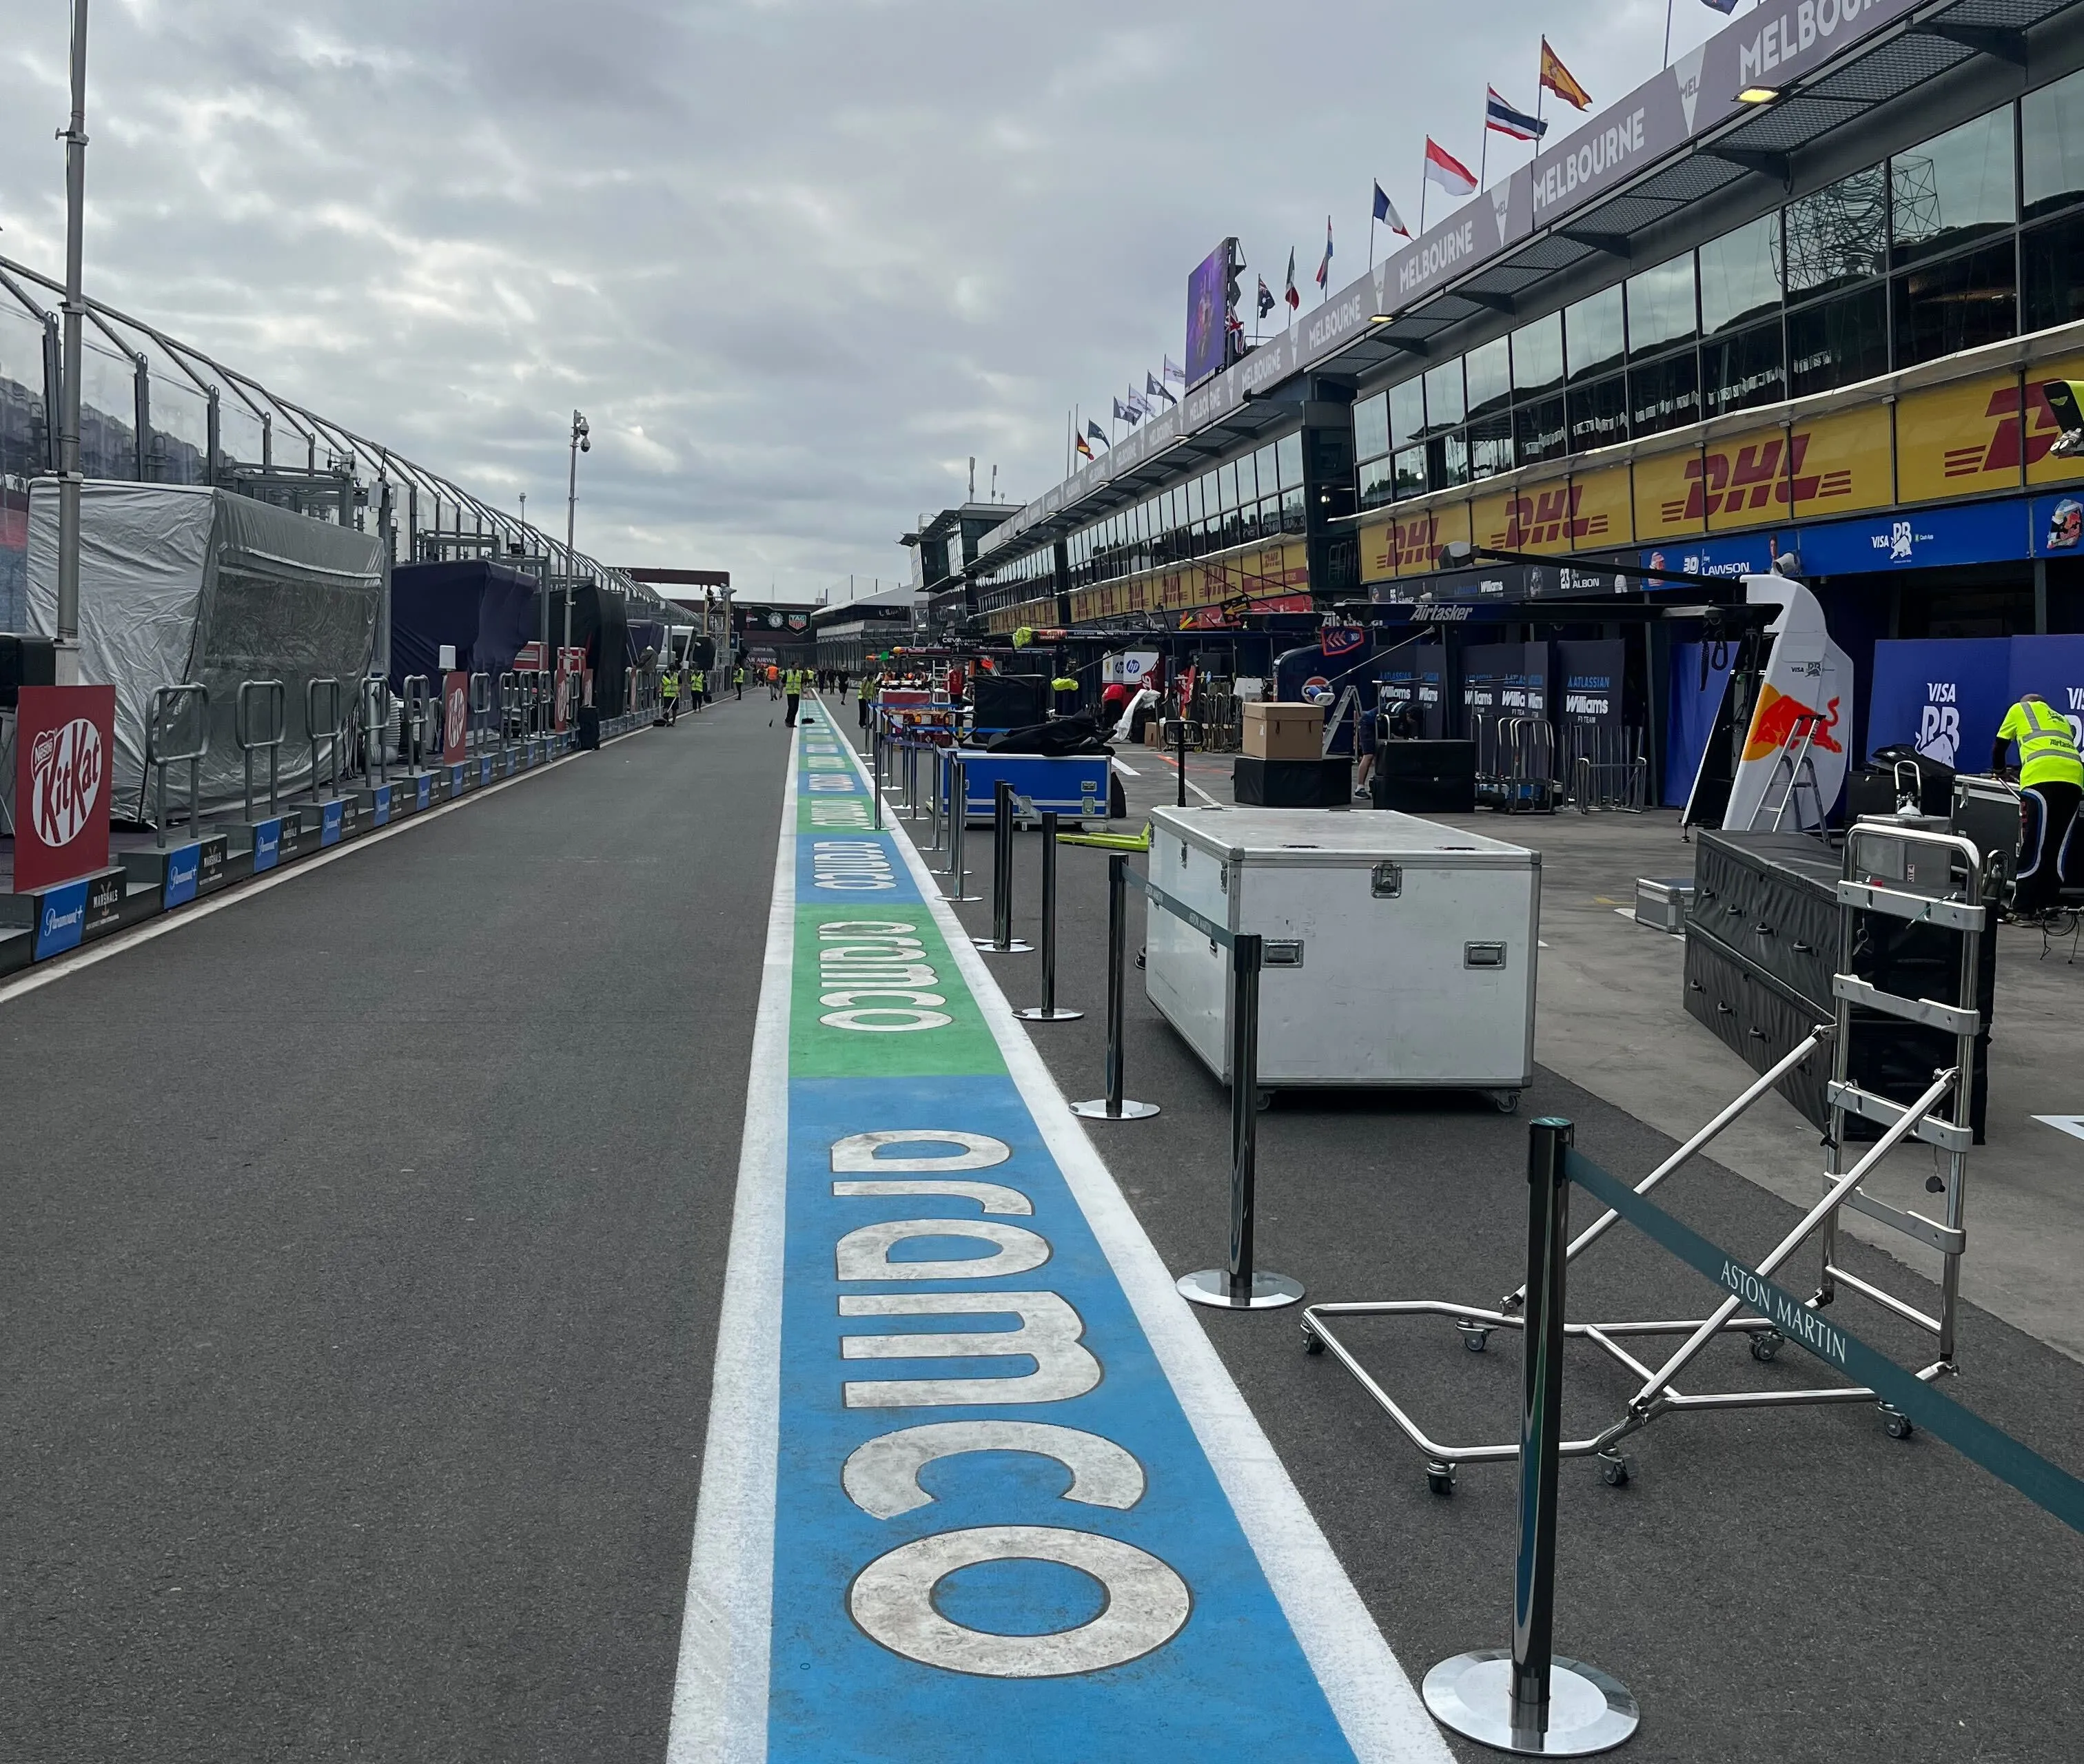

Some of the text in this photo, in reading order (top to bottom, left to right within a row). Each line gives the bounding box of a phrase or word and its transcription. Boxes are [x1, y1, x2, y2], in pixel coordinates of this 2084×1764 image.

[1679, 75, 1699, 99] MEL
[1533, 107, 1645, 213] MELBOURNE
[1399, 220, 1474, 294] MELBOURNE
[1309, 294, 1362, 350] MELBOURNE
[1241, 347, 1282, 391] MELBOURNE
[1684, 433, 1821, 520] DHL
[1505, 484, 1590, 549] DHL
[1385, 517, 1444, 568] DHL
[1871, 535, 1890, 548] VISA
[1683, 556, 1699, 574] 30
[1702, 562, 1750, 576] LAWSON
[1480, 580, 1504, 594] Williams
[1560, 568, 1570, 589] 23
[1572, 577, 1600, 589] ALBON
[1409, 604, 1473, 621] Airtasker
[1128, 659, 1138, 674] hp
[1380, 686, 1411, 699] Williams
[1573, 677, 1610, 688] ATLASSIAN
[1927, 683, 1956, 703] VISA
[1502, 690, 1525, 707] Willia
[1566, 695, 1608, 714] Williams
[41, 722, 100, 844] KitKat
[813, 842, 897, 890] aramco
[93, 889, 119, 908] MARSHALS
[44, 905, 83, 937] Paramount+
[818, 921, 953, 1032] aramco
[1721, 1260, 1846, 1364] ASTON MARTIN
[832, 1129, 1193, 1679] aramco
